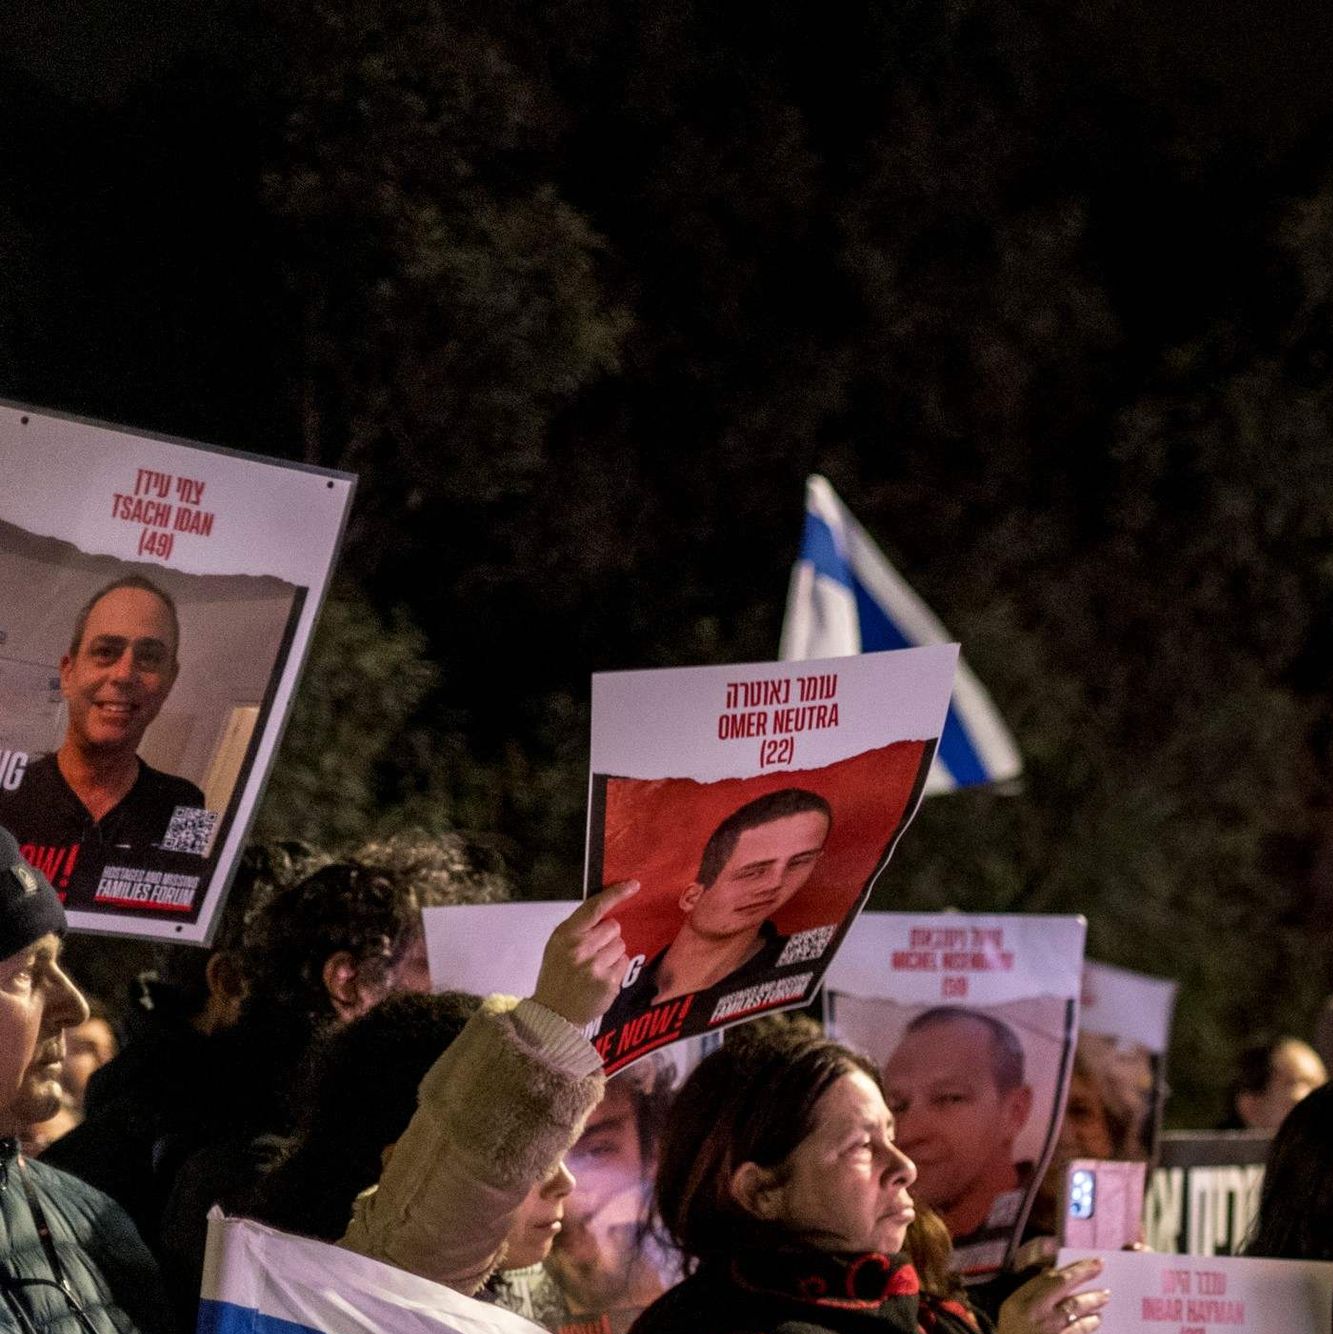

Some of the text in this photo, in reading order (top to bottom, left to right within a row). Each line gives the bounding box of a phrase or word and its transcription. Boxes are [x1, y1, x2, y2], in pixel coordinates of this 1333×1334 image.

[134, 469, 205, 505] צחי עידן
[112, 493, 214, 537] TSACHI IDAN
[138, 527, 174, 561] (49)
[726, 674, 838, 709] עומר נאוטרה
[718, 703, 839, 740] OMER NEUTRA
[760, 736, 795, 768] (22)
[98, 879, 196, 906] FAMILIES FORUM
[616, 994, 695, 1055] NOW!
